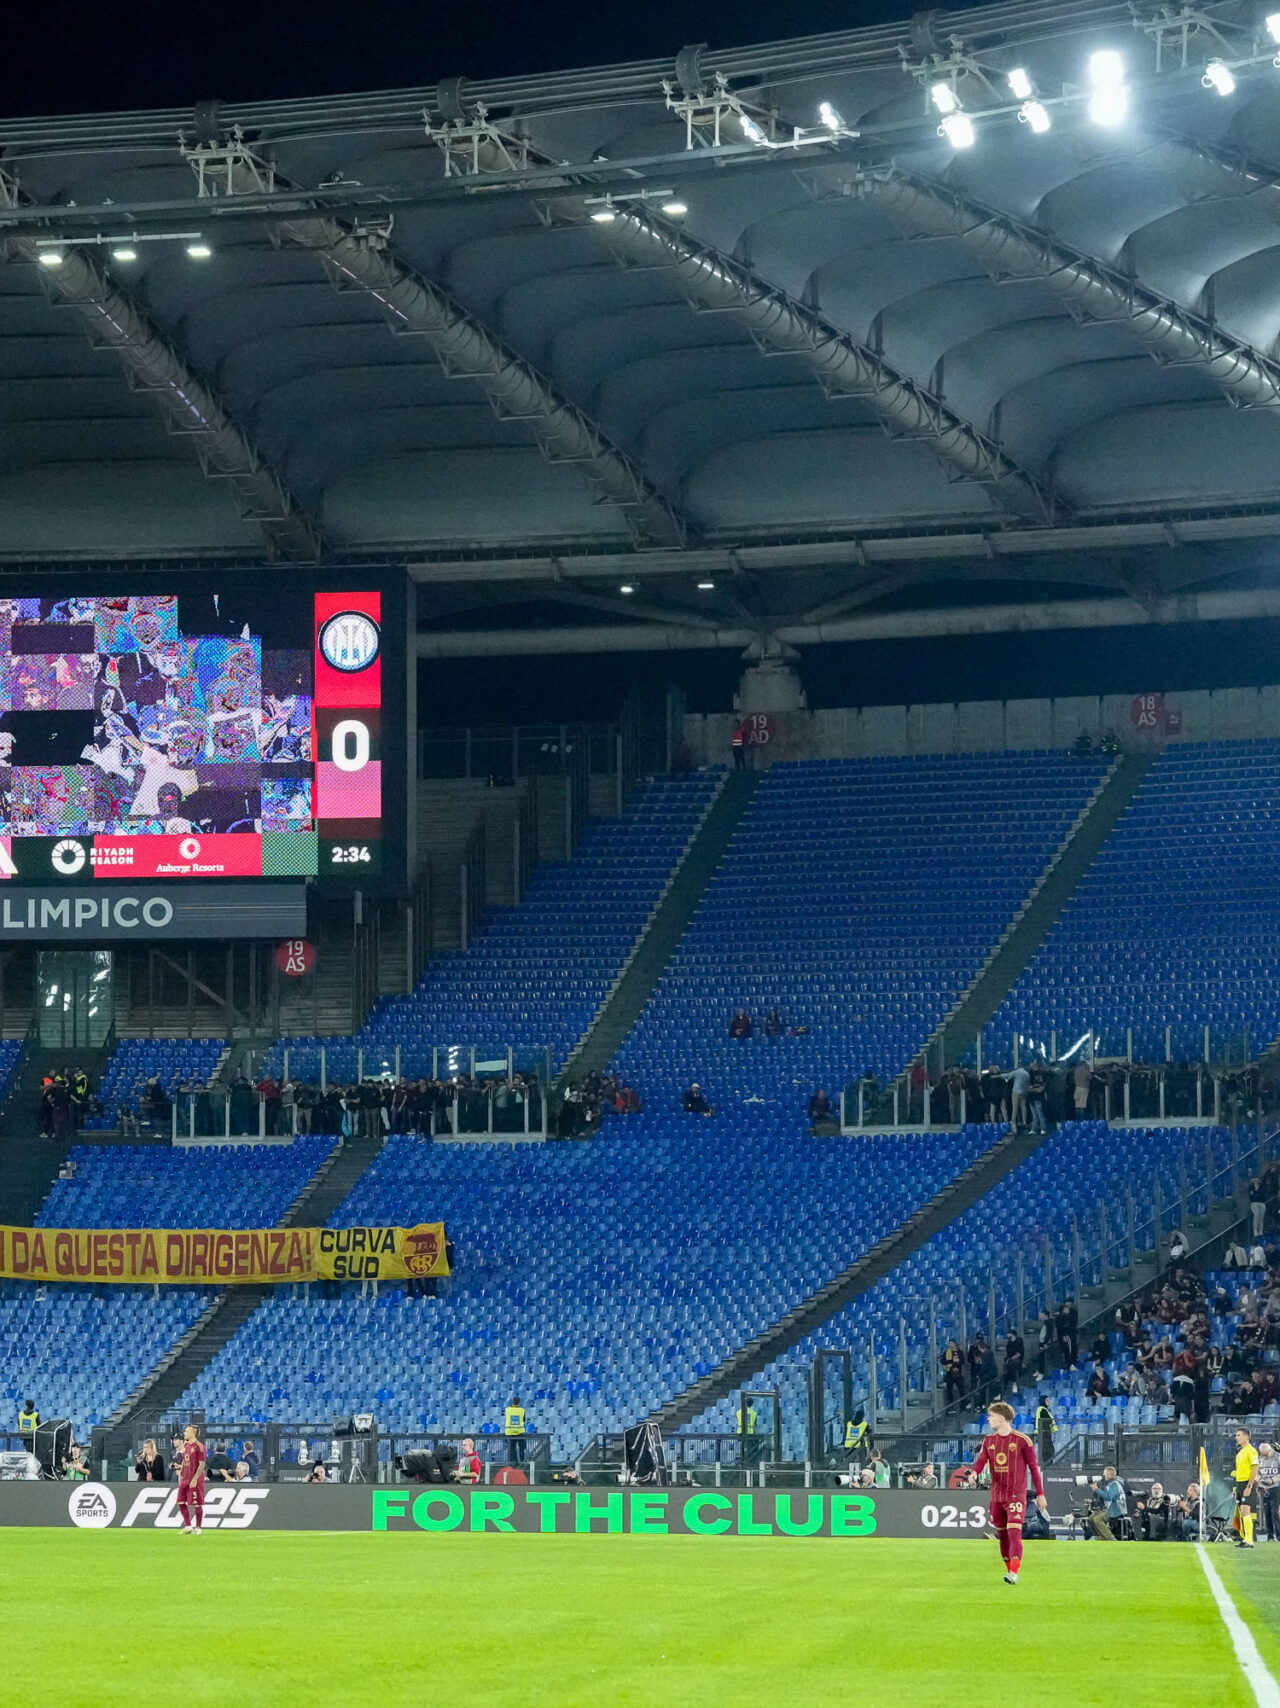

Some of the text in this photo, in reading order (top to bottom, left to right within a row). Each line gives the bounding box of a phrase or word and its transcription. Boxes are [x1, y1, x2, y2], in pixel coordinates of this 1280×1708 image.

[1139, 696, 1155, 711] 18
[751, 714, 767, 729] 19
[1138, 711, 1157, 726] AS
[749, 730, 769, 745] AD
[331, 719, 370, 772] 0
[90, 848, 134, 856] RIYADH
[331, 846, 371, 863] 2:34
[90, 856, 134, 865] SEASON
[286, 940, 304, 956] 19
[285, 957, 306, 972] AS
[320, 1228, 396, 1254] CURVA
[12, 1231, 49, 1274] DA
[55, 1232, 160, 1277] QUESTA
[166, 1231, 312, 1277] DIRIGENZA!
[333, 1255, 380, 1279] SUD
[77, 1493, 108, 1509] EA
[1009, 1501, 1023, 1513] 59
[76, 1509, 109, 1518] SPORTS
[372, 1490, 877, 1536] FOR THE CLUB
[921, 1505, 996, 1528] 02:3
